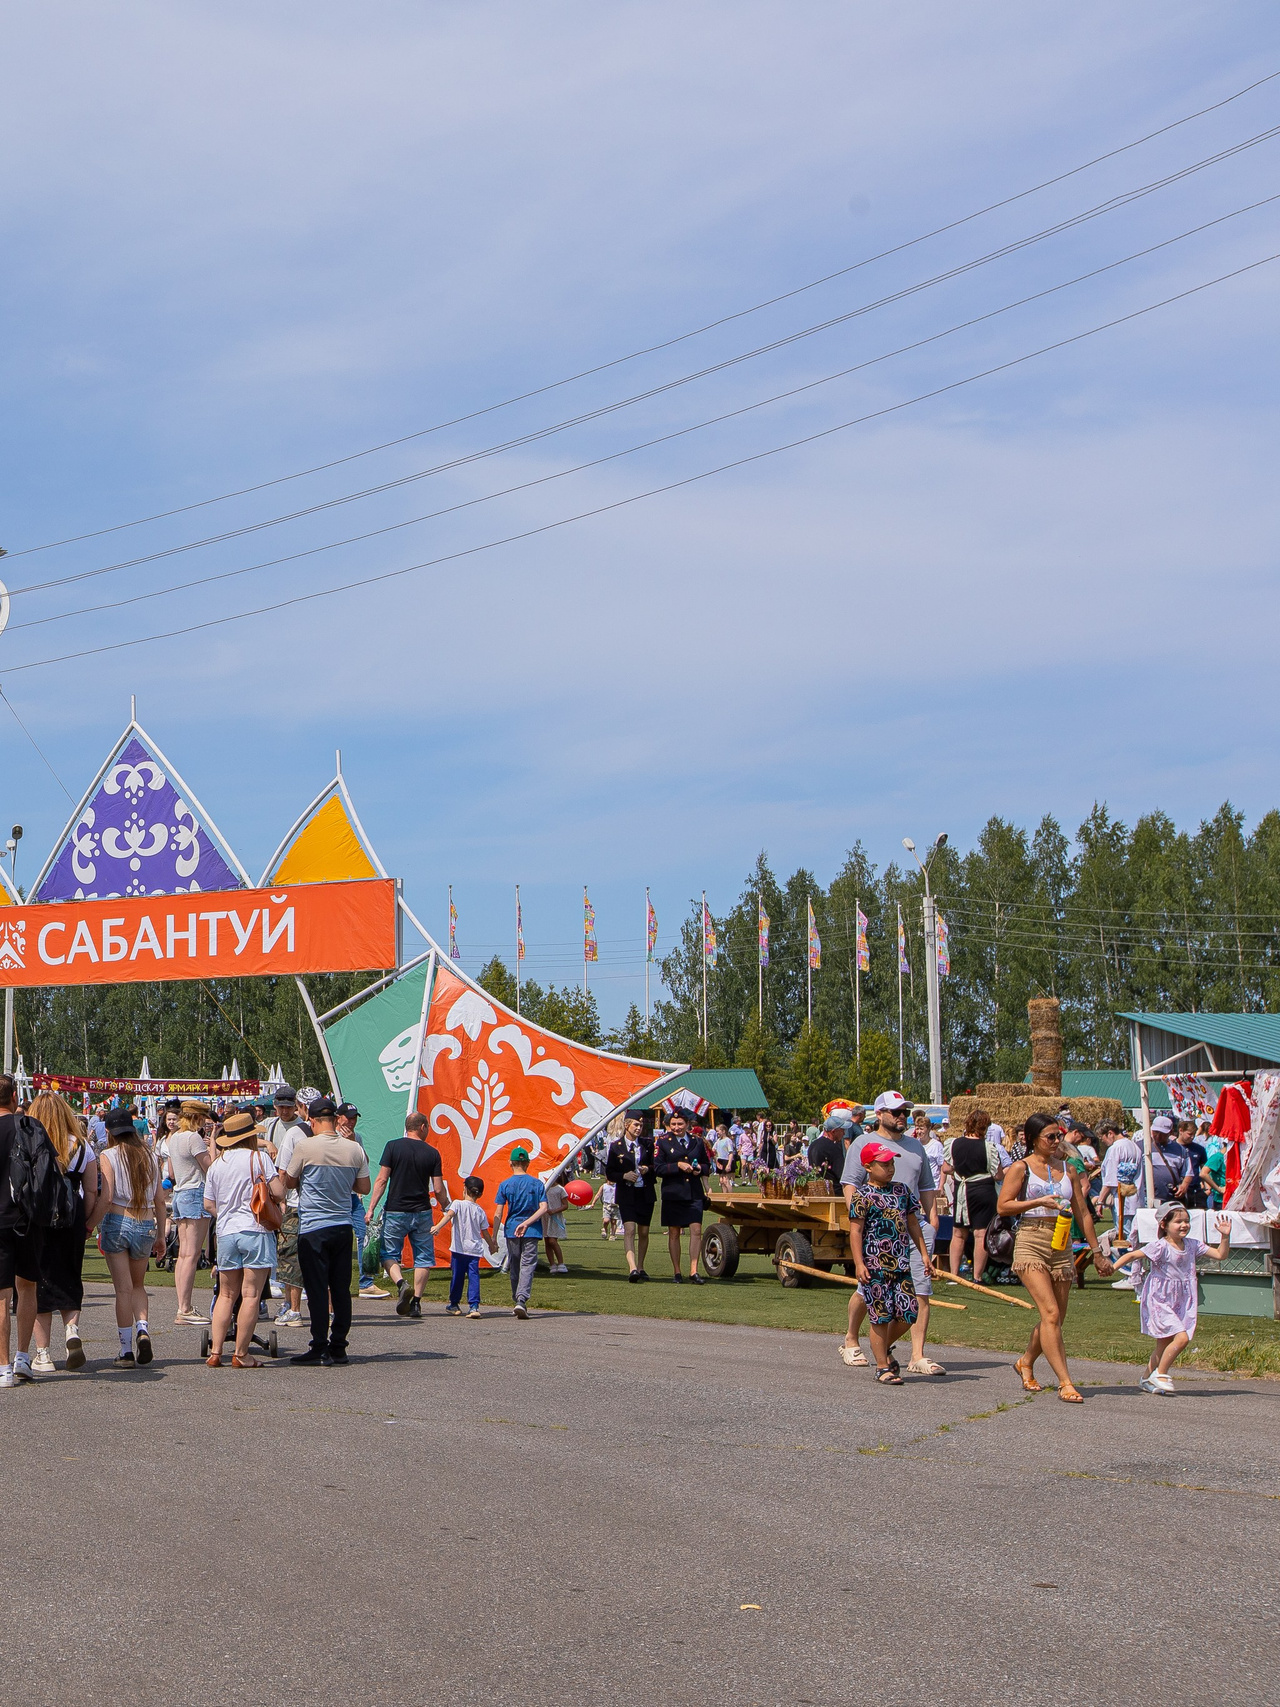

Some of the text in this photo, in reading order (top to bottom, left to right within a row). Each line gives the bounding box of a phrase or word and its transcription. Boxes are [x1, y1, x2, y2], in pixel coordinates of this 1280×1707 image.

[37, 894, 295, 966] САБАНТУЙ
[89, 1080, 209, 1092] БОГОРОДСКАЯ ЯРМАРКА
